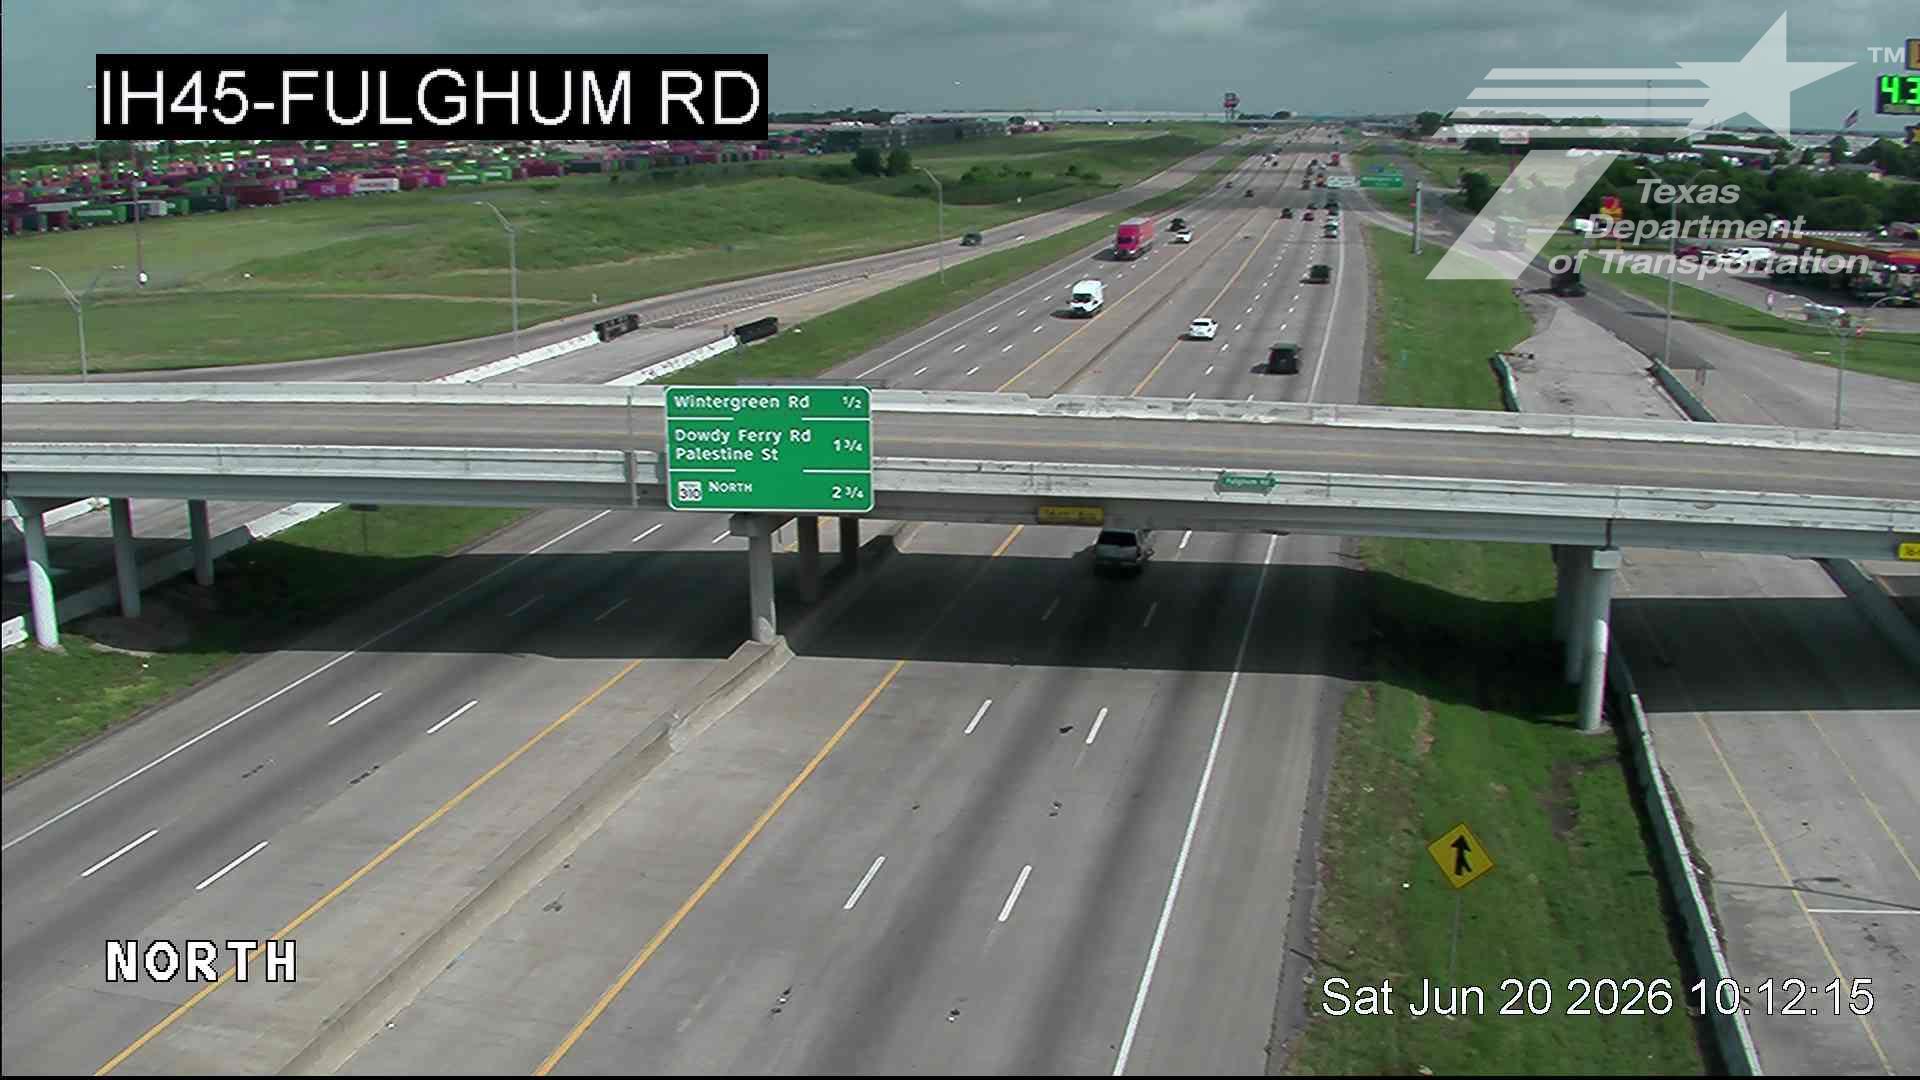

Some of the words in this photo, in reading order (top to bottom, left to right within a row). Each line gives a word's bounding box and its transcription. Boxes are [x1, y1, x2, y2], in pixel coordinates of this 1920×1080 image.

[674, 395, 780, 412] Wintergreen
[788, 395, 810, 409] Rd
[675, 428, 730, 445] Dowdy
[738, 429, 782, 445] Ferry
[789, 429, 811, 442] Rd
[675, 447, 754, 461] Palestine
[761, 447, 779, 461] St
